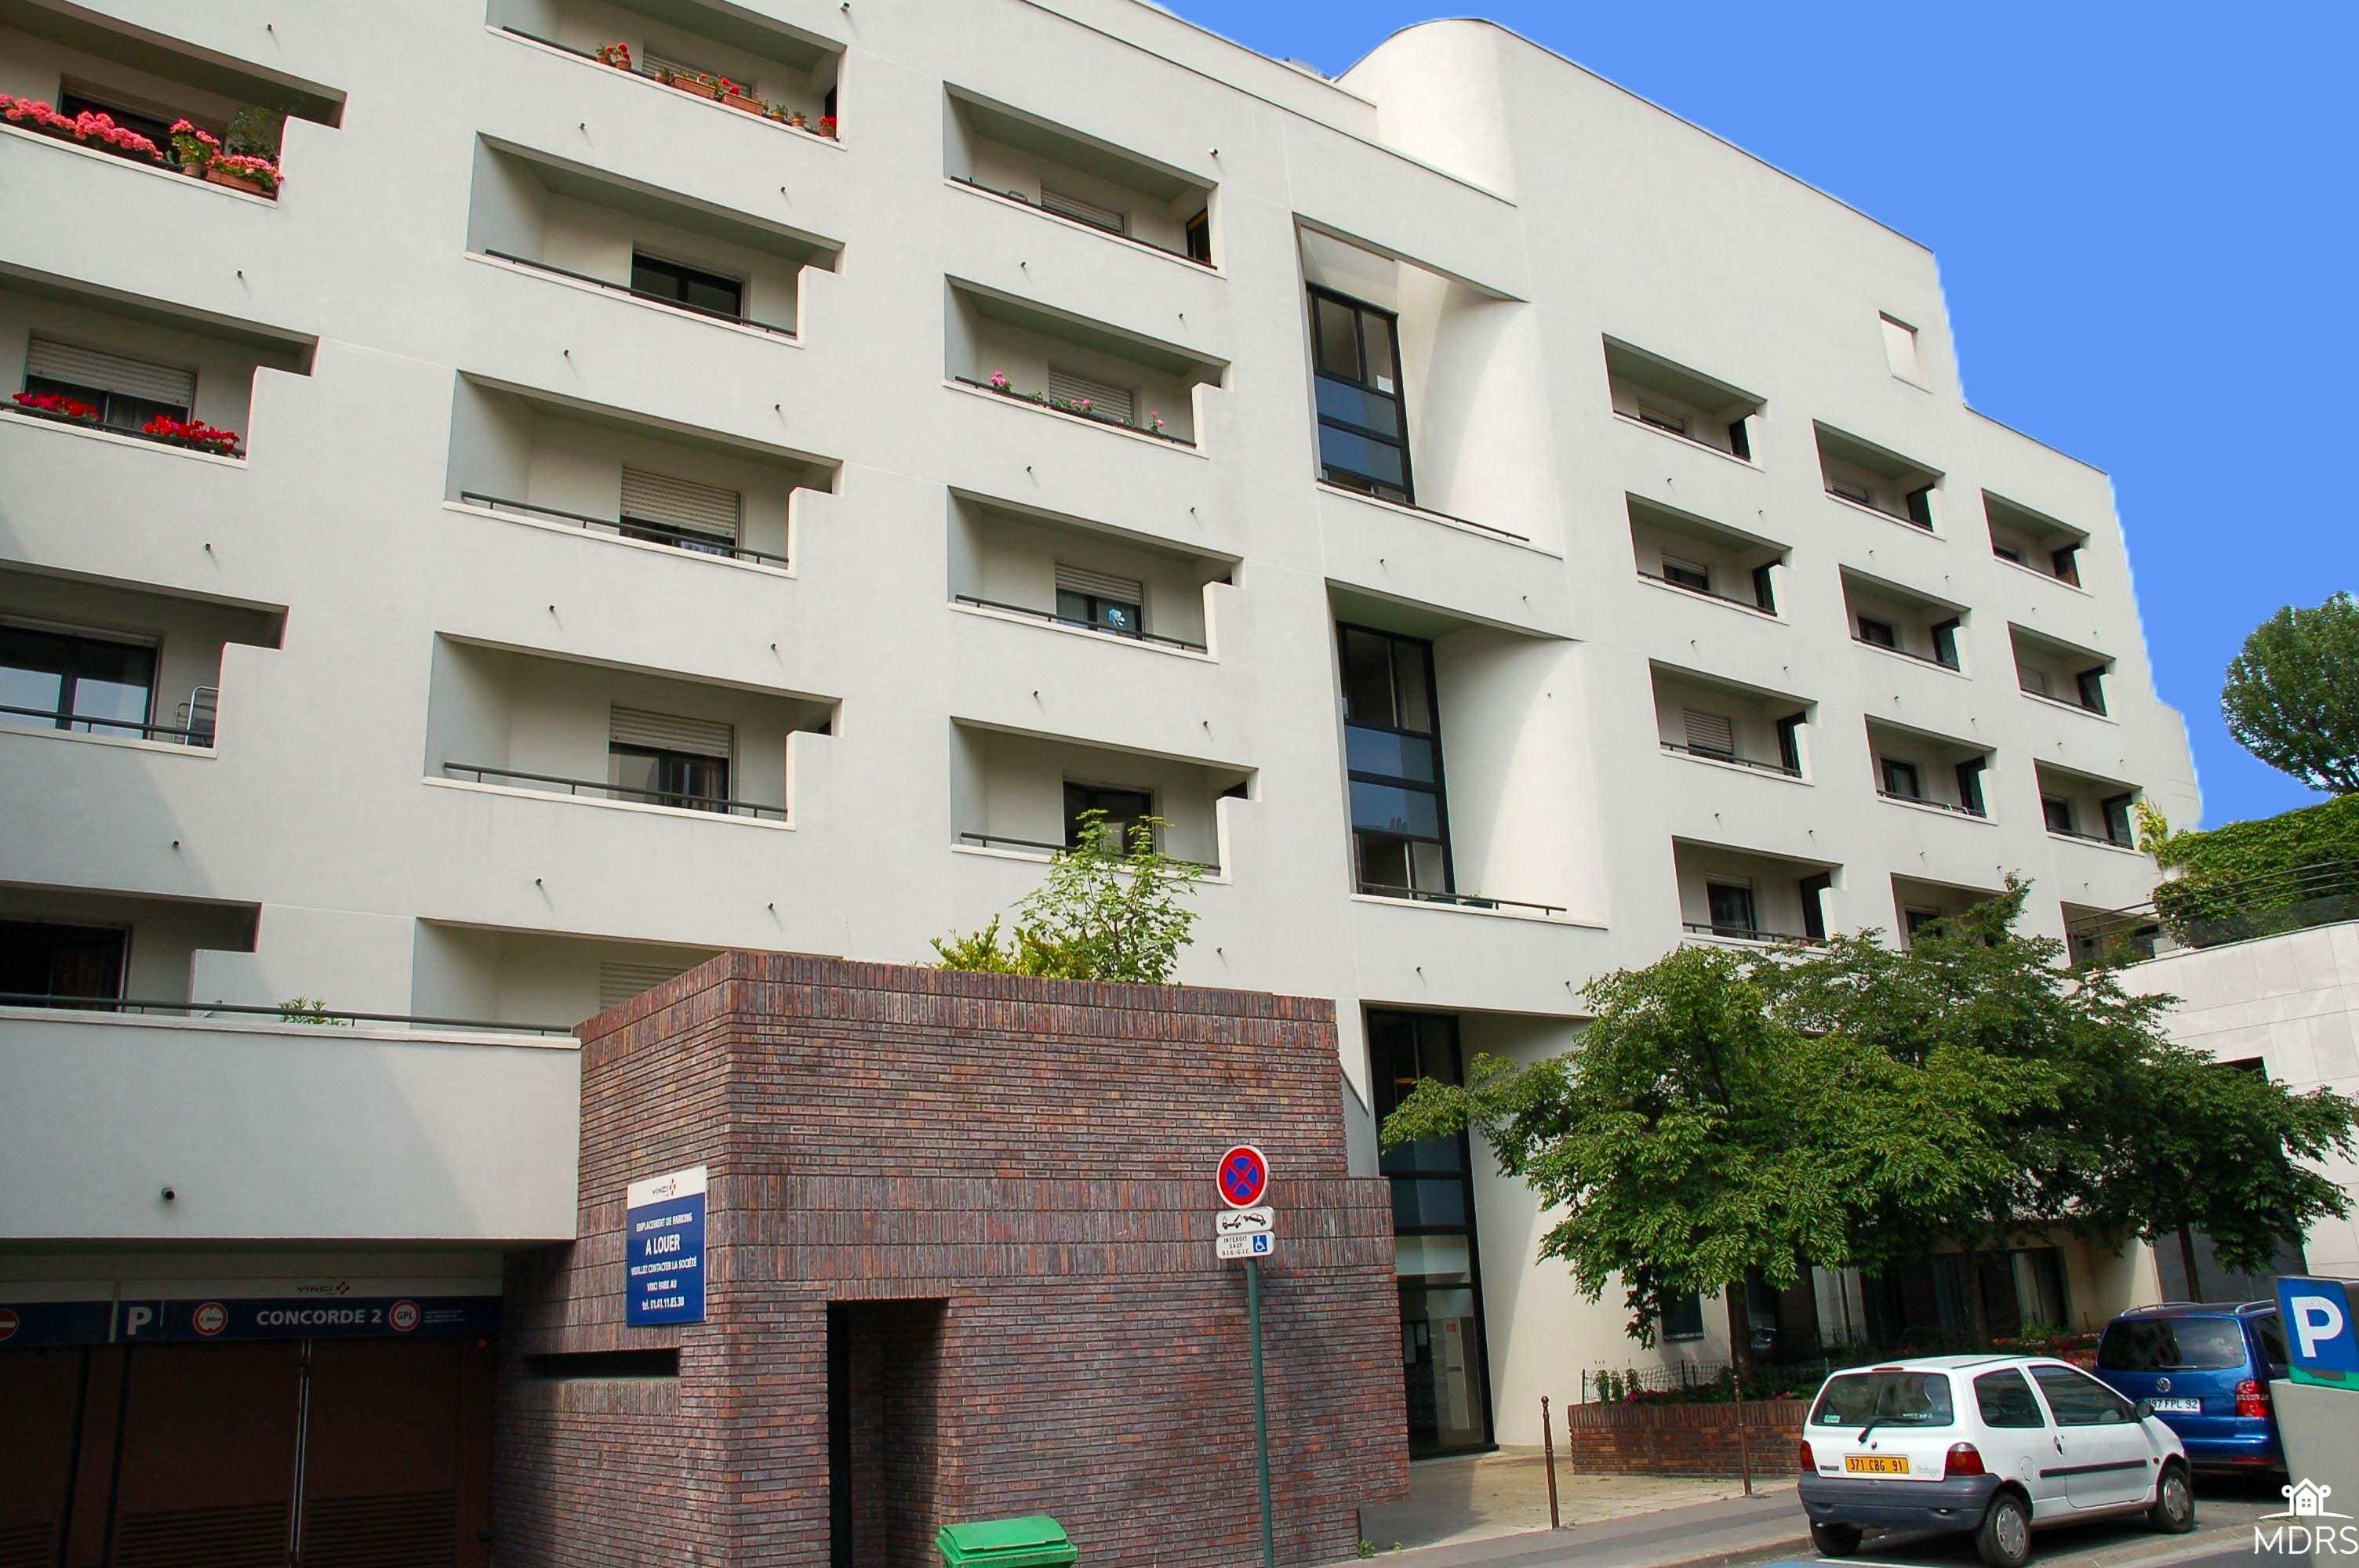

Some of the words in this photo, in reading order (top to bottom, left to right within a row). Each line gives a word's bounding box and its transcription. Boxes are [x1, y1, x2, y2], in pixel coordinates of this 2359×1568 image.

[666, 1217, 672, 1226] DE
[645, 1239, 652, 1255] A
[653, 1233, 680, 1254] LOUER
[672, 1260, 678, 1270] LA
[127, 1306, 153, 1336] P
[256, 1309, 365, 1327] CONCORDE
[371, 1308, 383, 1324] 2
[397, 1312, 414, 1320] GPL
[2290, 1296, 2343, 1358] P
[2146, 1399, 2162, 1409] 97
[2165, 1399, 2183, 1409] FPL
[2186, 1399, 2197, 1410] 92
[1850, 1459, 1865, 1471] 371
[1869, 1459, 1885, 1472] CBG
[1892, 1460, 1903, 1472] 91
